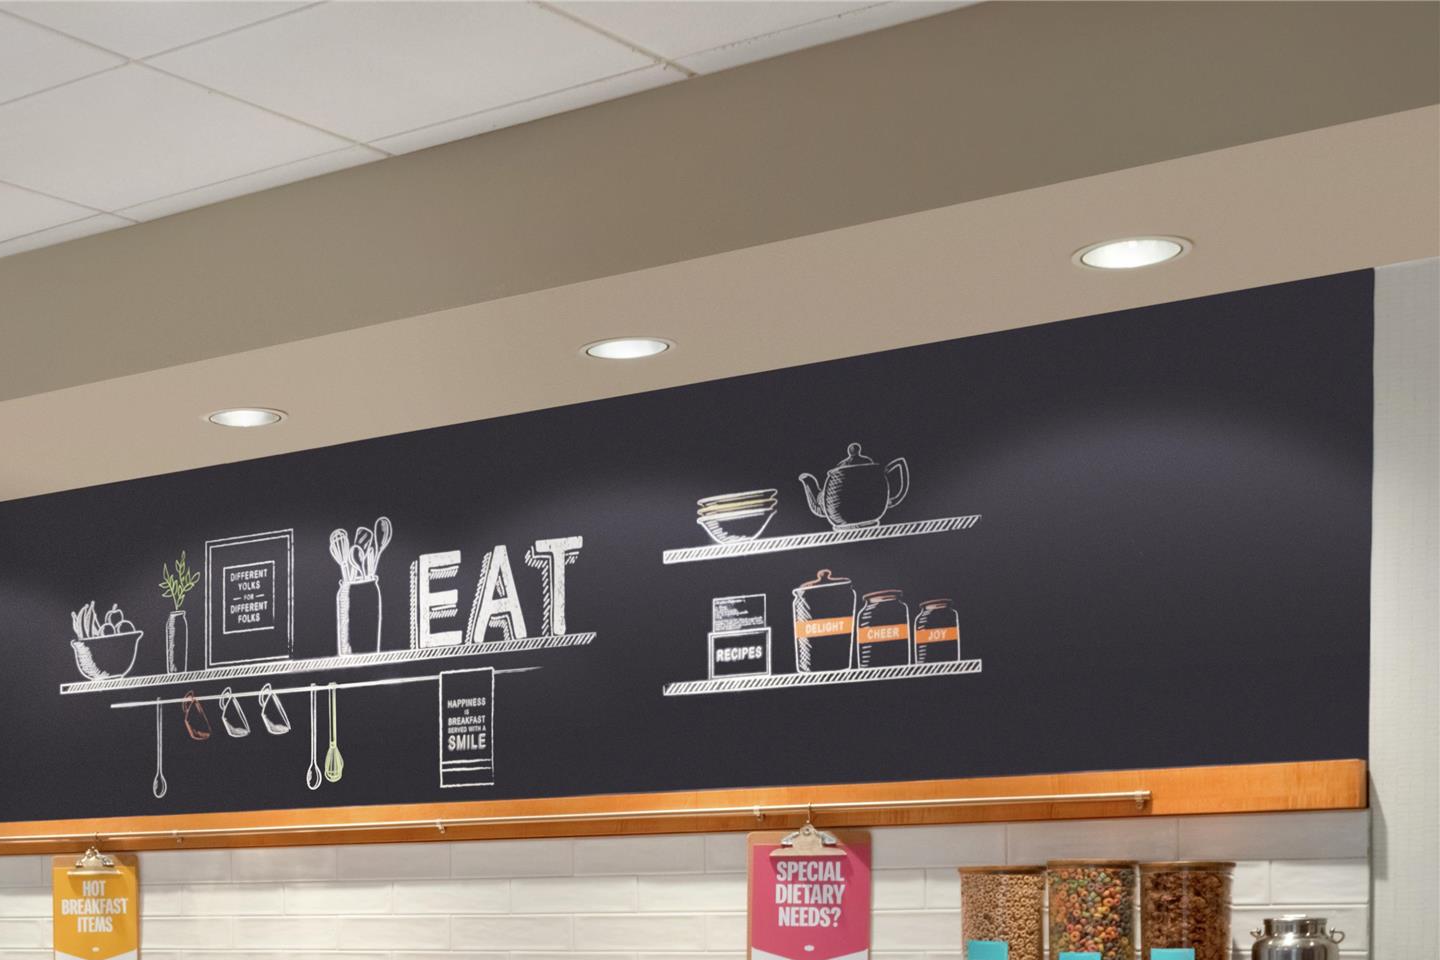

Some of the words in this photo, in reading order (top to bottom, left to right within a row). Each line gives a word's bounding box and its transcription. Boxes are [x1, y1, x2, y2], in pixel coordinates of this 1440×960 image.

[230, 568, 268, 582] DIFFERENT
[238, 580, 261, 590] YOLKS
[243, 593, 254, 601] FOR
[410, 535, 583, 650] EAT
[230, 601, 268, 614] DIFFERENT
[238, 612, 260, 623] FOLKS
[805, 620, 844, 635] DELIGHT
[867, 628, 900, 639] CHEER
[928, 629, 947, 640] JOY
[716, 646, 762, 662] RECIPES
[447, 697, 486, 708] HAPPINESS
[448, 715, 486, 726] BREAKFAST
[448, 726, 467, 734] SERVED
[448, 733, 487, 751] SMILE
[776, 861, 845, 882] SPECIAL
[82, 880, 106, 897] HOT
[775, 884, 846, 905] DIETARY
[62, 897, 128, 915] BREAKFAST
[77, 915, 113, 933] ITEMS
[778, 906, 842, 928] NEEDS?
